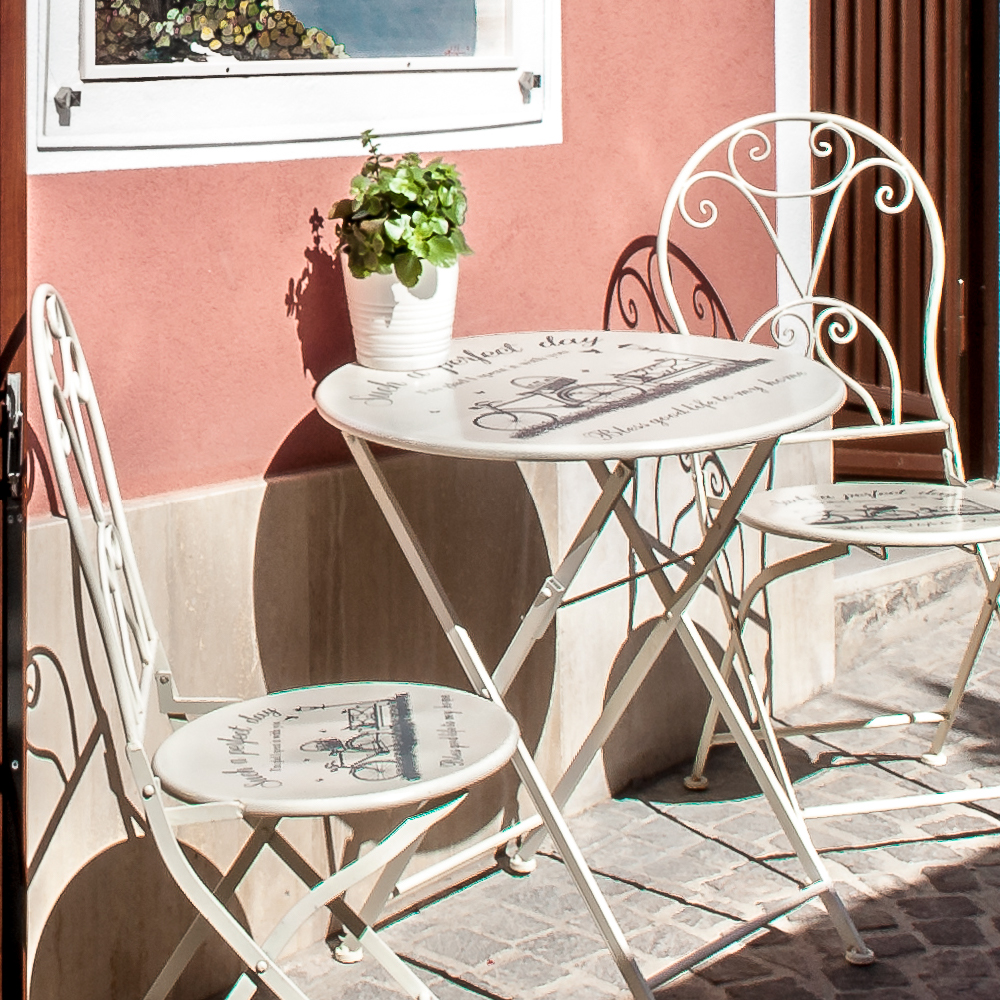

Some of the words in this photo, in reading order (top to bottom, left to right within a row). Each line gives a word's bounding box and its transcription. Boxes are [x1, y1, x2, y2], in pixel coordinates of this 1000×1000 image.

[350, 379, 406, 407] Such
[407, 370, 430, 379] a
[438, 343, 523, 375] perfect
[539, 335, 602, 348] day
[238, 708, 282, 724] day
[217, 726, 260, 756] perfect
[221, 767, 282, 788] Such
